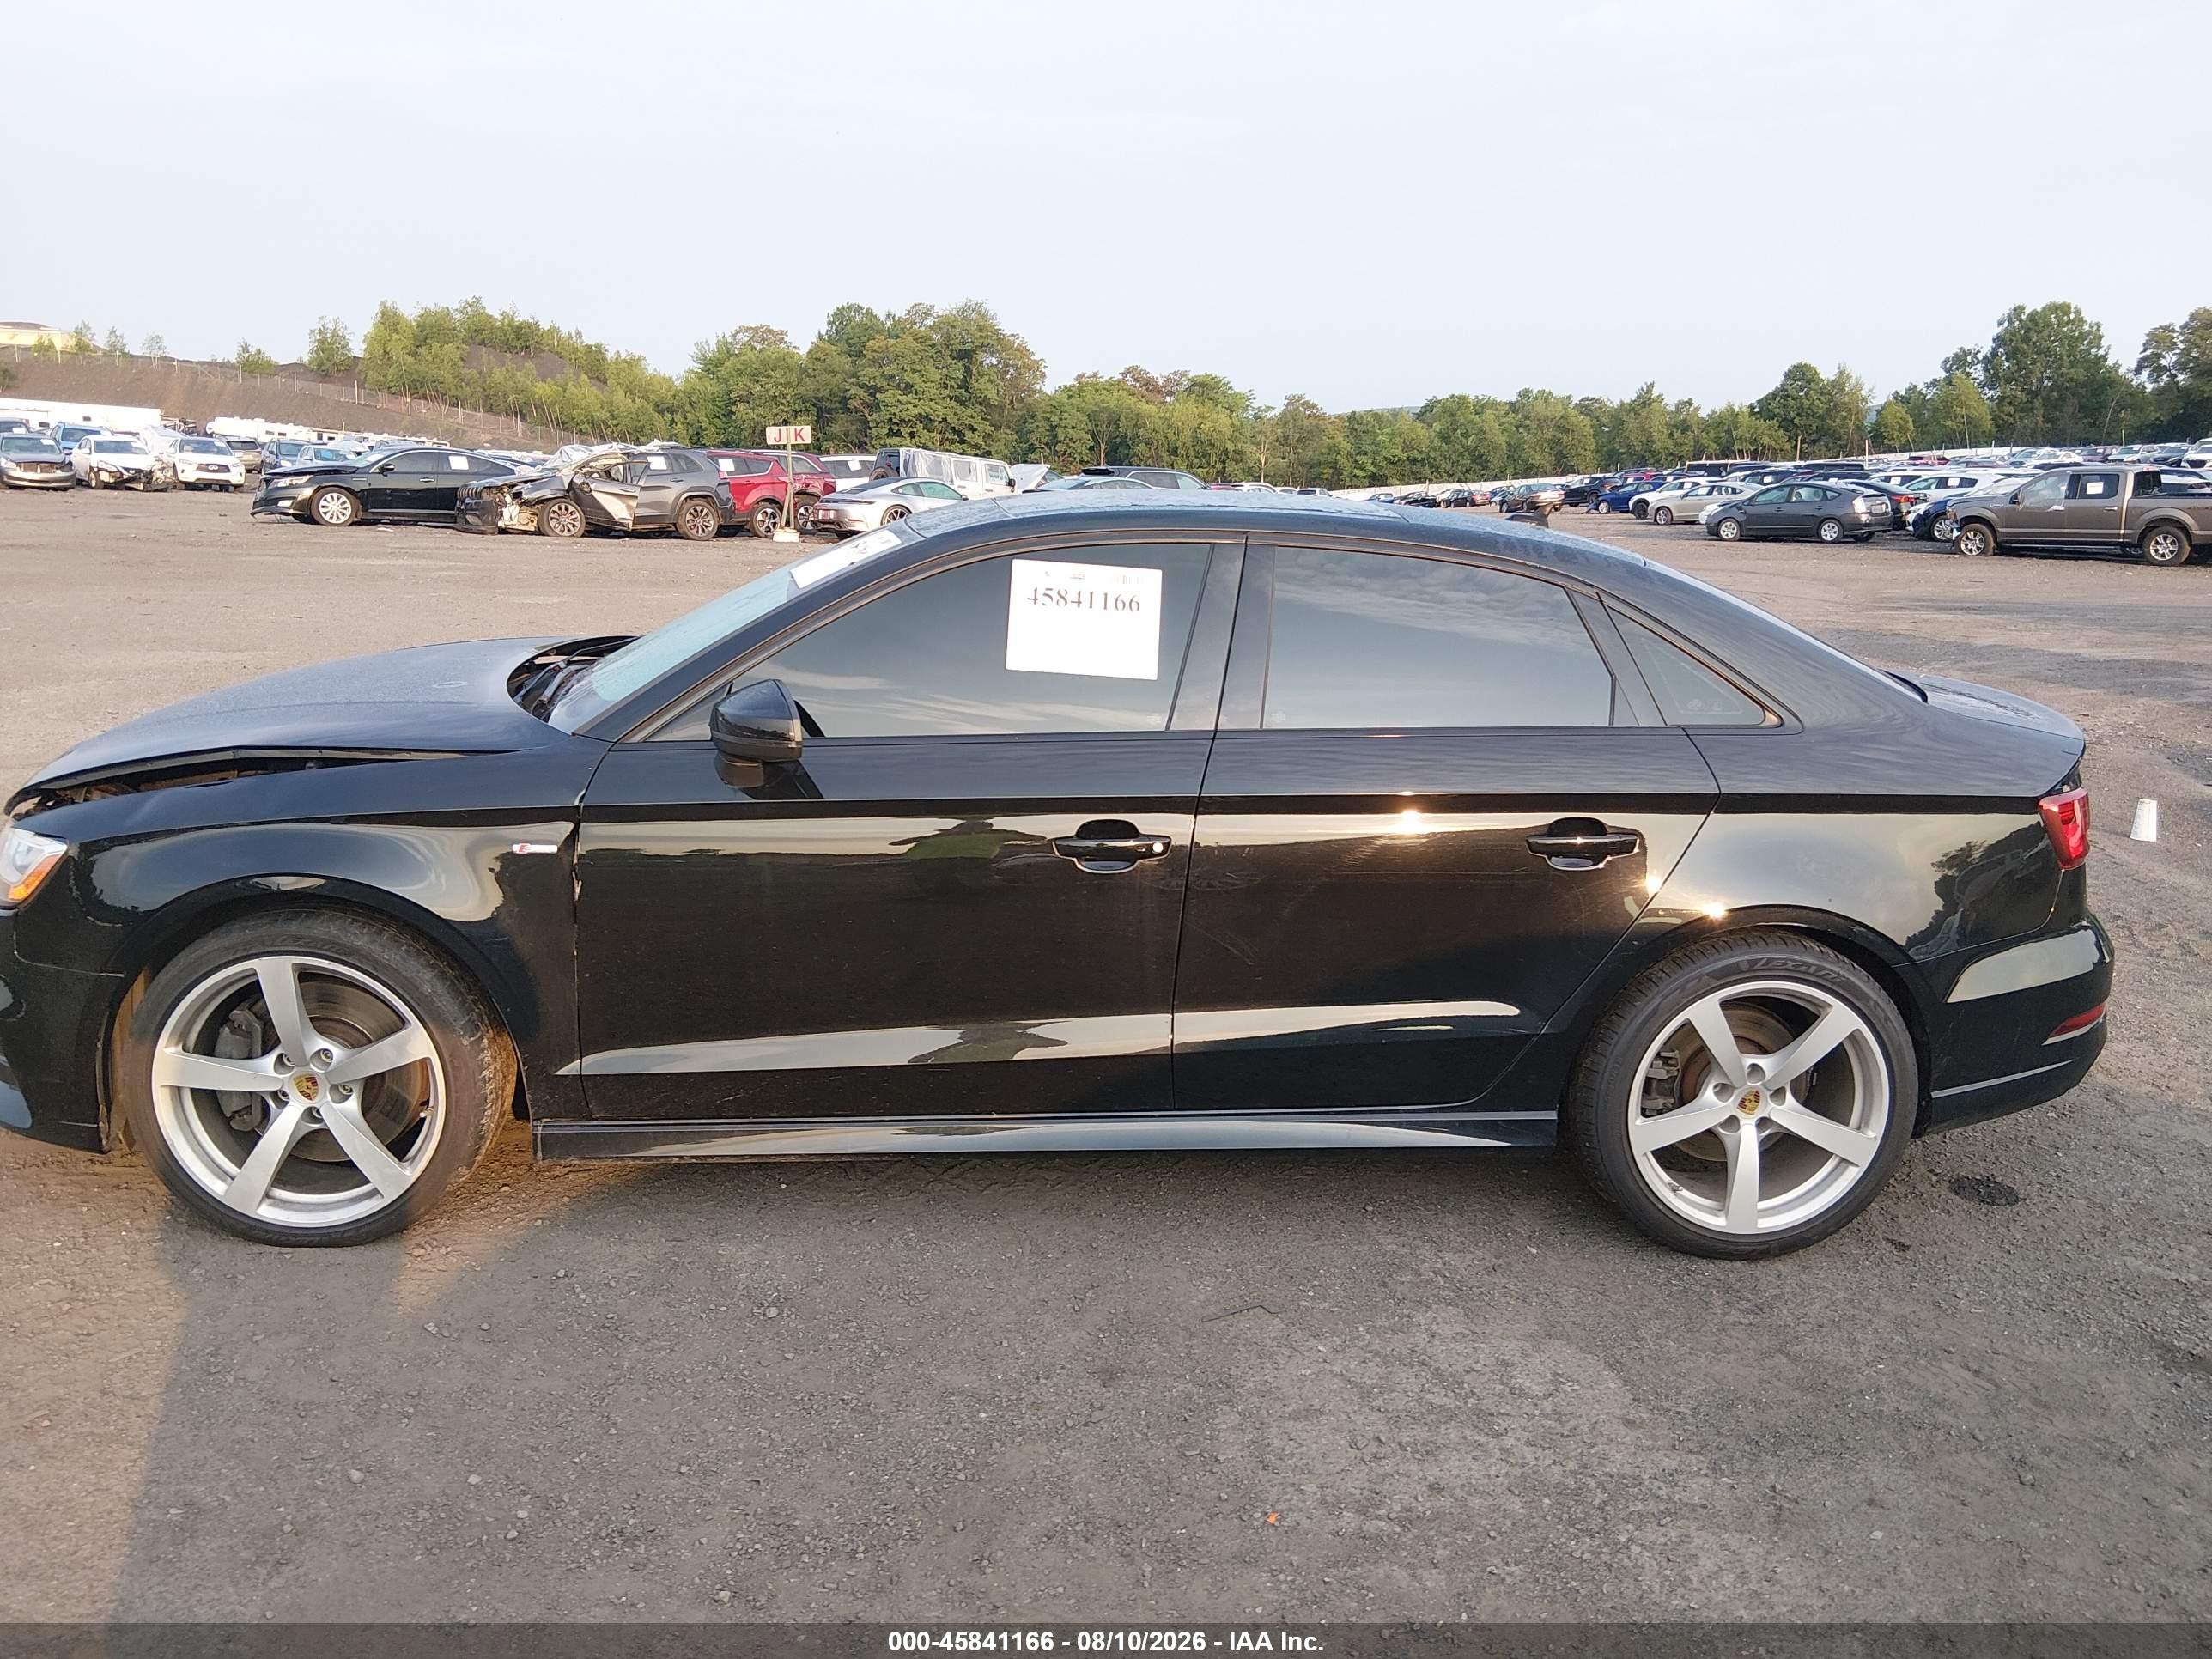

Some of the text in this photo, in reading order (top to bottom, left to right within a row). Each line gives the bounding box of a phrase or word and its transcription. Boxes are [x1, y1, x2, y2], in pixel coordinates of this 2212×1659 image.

[773, 428, 805, 443] J K
[1027, 586, 1141, 613] 45841166
